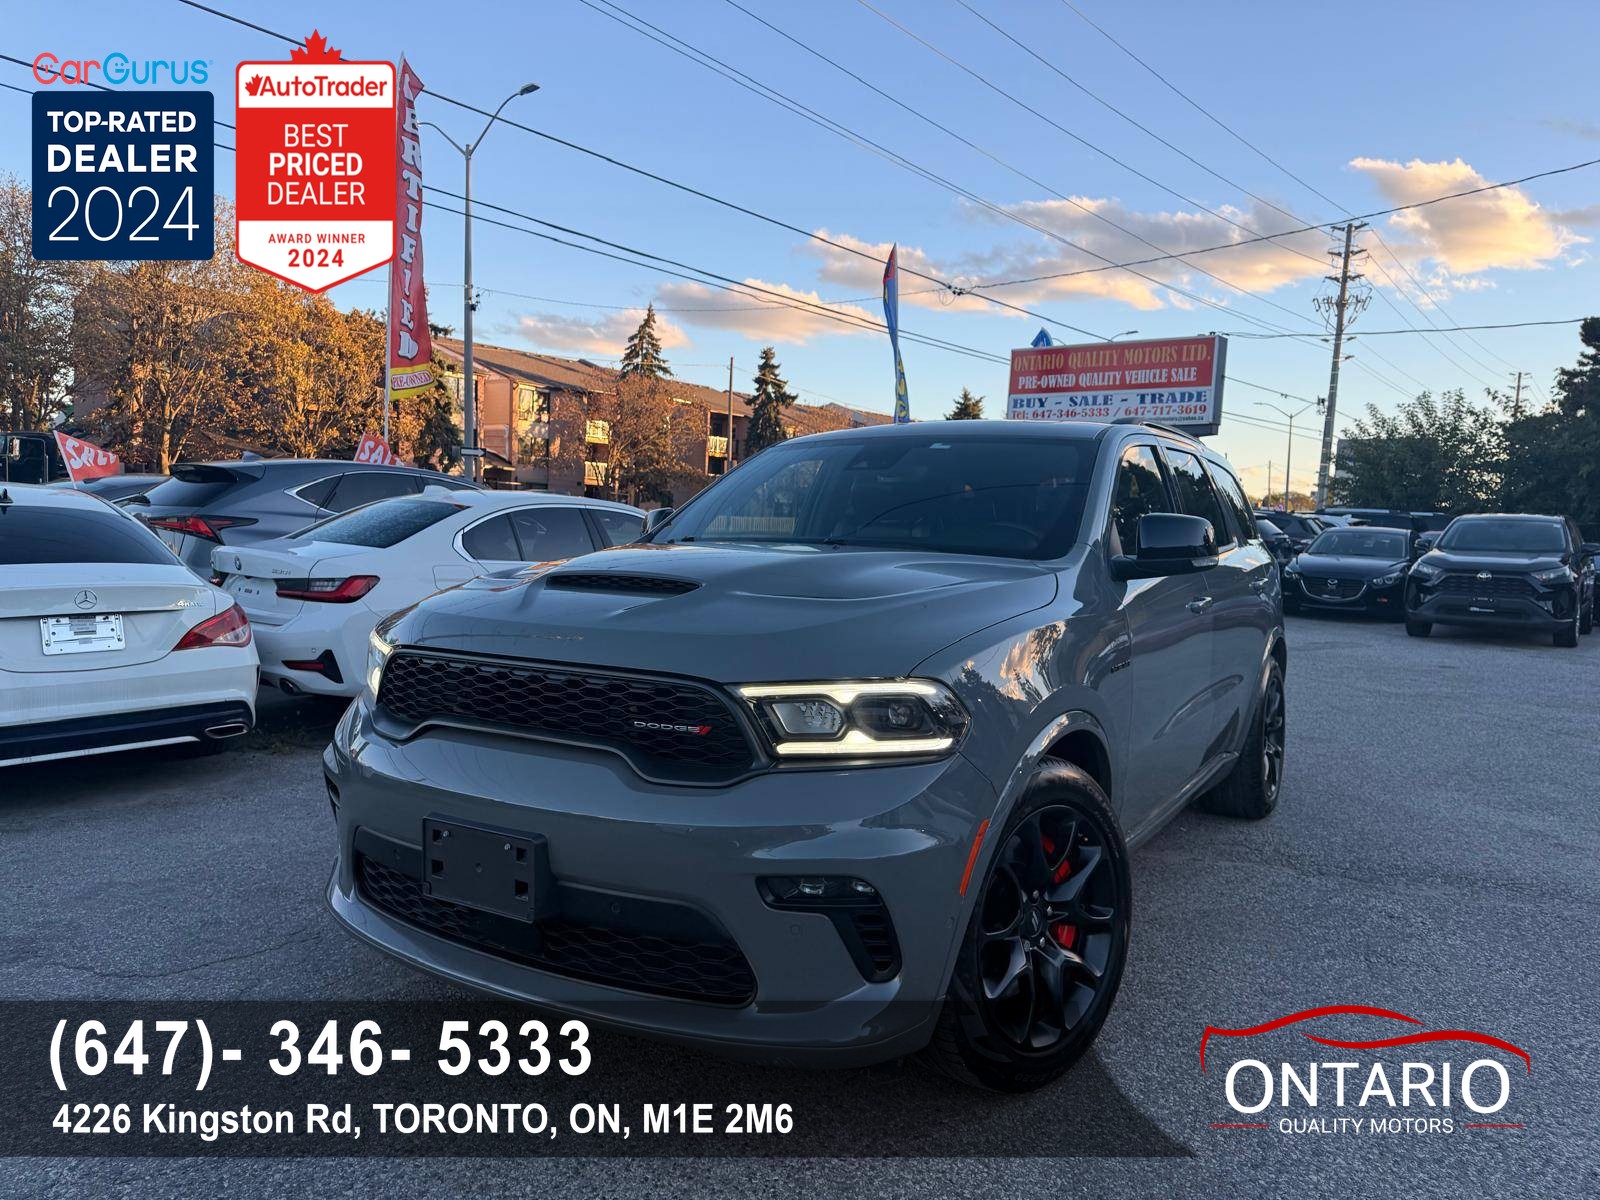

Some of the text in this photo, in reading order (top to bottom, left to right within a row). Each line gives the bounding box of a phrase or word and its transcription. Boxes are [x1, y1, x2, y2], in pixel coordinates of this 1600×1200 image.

[1014, 352, 1064, 372] ONTARIO
[1068, 349, 1118, 370] QUALITY
[1123, 346, 1178, 366] MOTORS
[1018, 366, 1198, 390] PRE-OWNED QUALITY VEHICLE SALE
[1012, 397, 1049, 409] BUY
[1068, 394, 1114, 408] SALE
[1136, 389, 1208, 405] TRADE
[1032, 407, 1110, 419] 647-346-5333
[634, 721, 701, 733] DODGE
